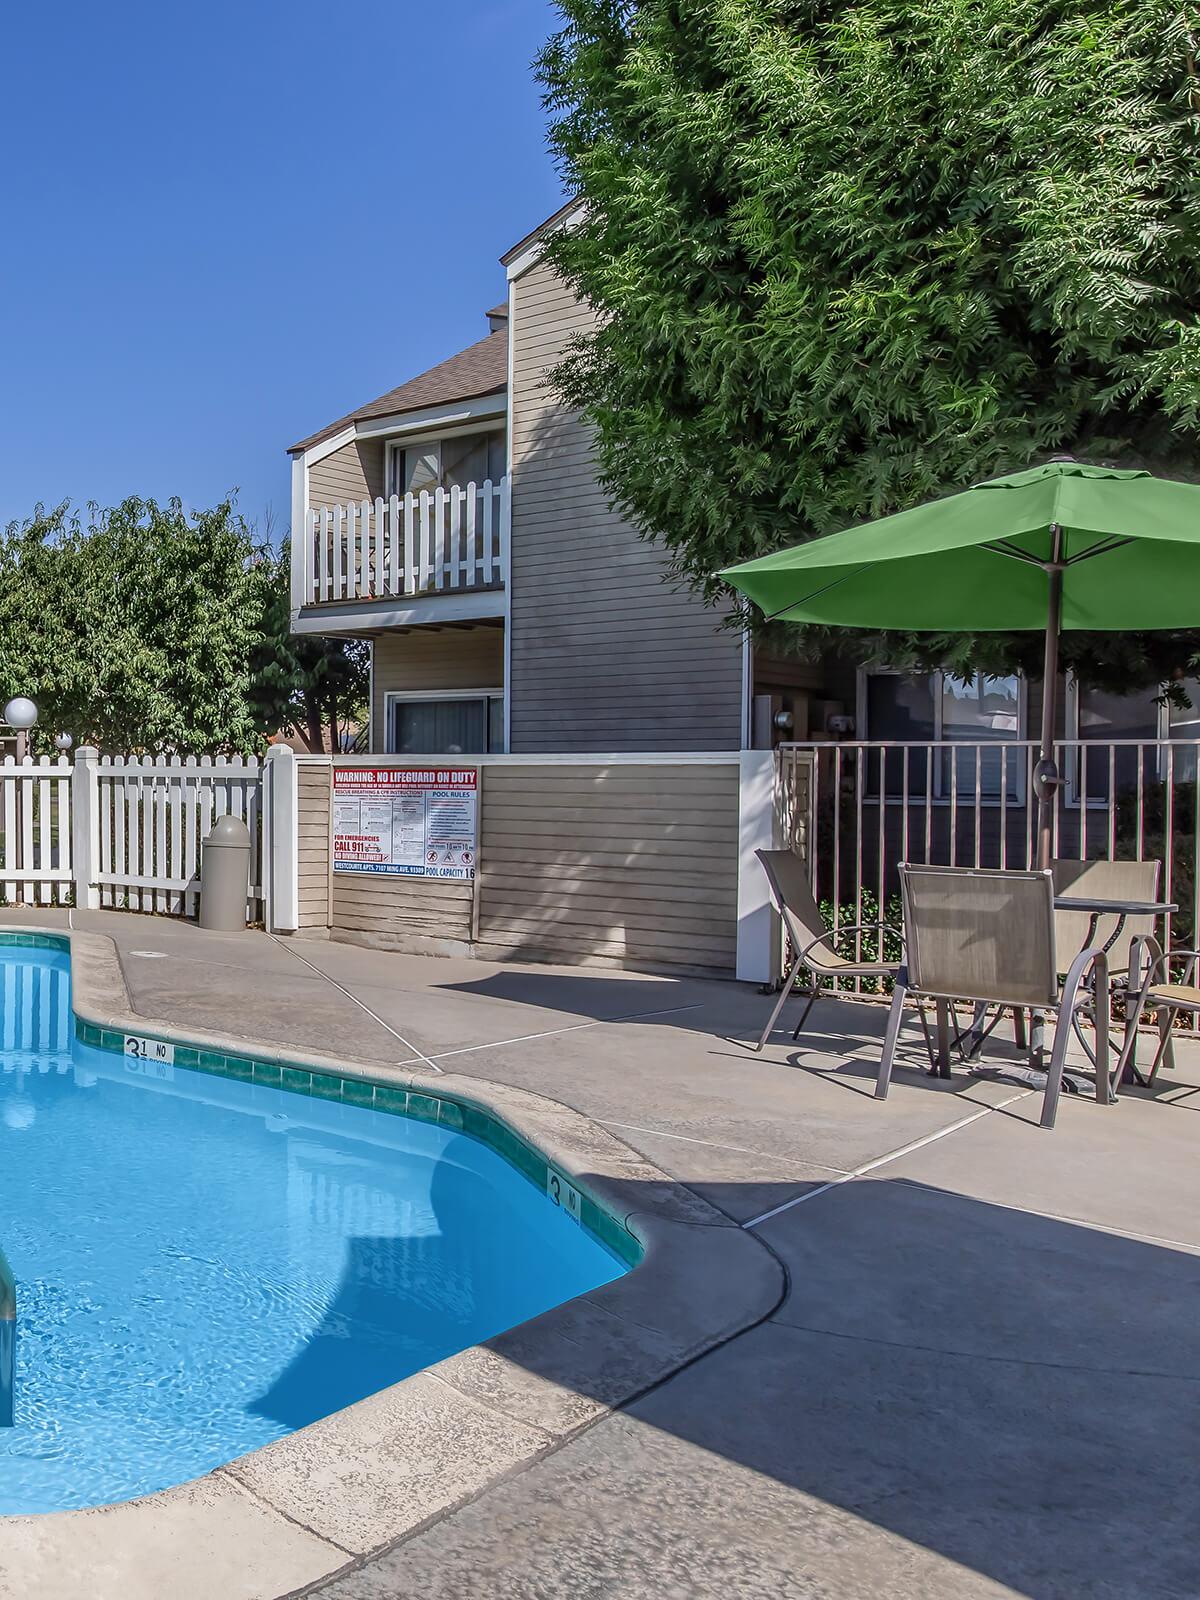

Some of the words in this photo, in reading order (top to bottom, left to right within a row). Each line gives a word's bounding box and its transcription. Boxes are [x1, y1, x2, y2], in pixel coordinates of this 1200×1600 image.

[335, 772, 376, 783] WARNING:
[377, 772, 388, 783] NO
[390, 772, 435, 783] LIFEGUARD
[437, 772, 449, 783] ON
[451, 772, 475, 783] DUTY
[335, 841, 350, 851] CALL
[352, 842, 364, 852] 911
[426, 867, 438, 876] POOL
[439, 868, 463, 877] CAPACITY
[465, 868, 475, 879] 16
[126, 1038, 139, 1058] 3
[156, 1044, 166, 1057] NO
[550, 1175, 561, 1207] 3
